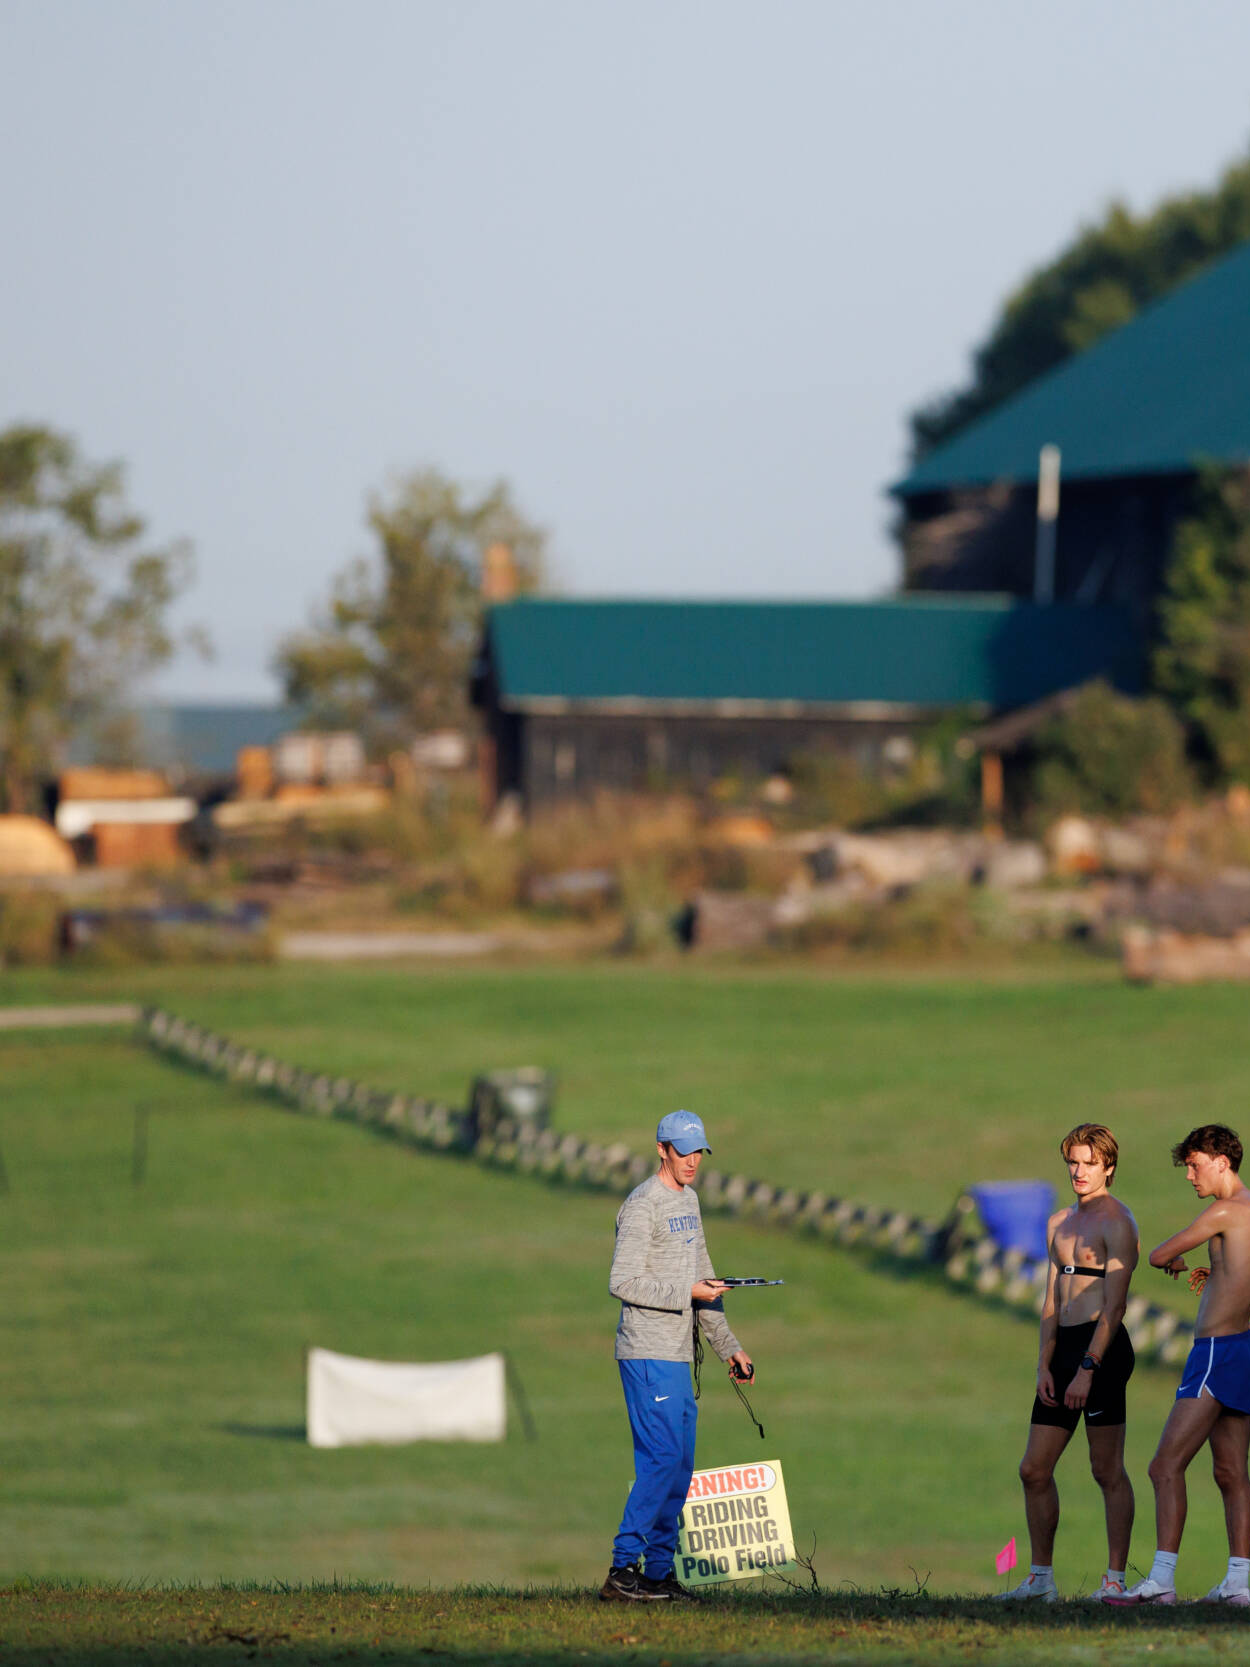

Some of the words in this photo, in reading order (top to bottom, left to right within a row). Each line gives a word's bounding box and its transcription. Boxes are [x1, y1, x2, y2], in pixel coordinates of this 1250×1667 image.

[668, 1215, 698, 1233] KENTUC
[686, 1466, 767, 1499] RNING!
[691, 1495, 769, 1527] RIDING
[687, 1519, 779, 1553] DRIVING
[681, 1553, 730, 1579] Polo
[734, 1543, 788, 1572] Field
